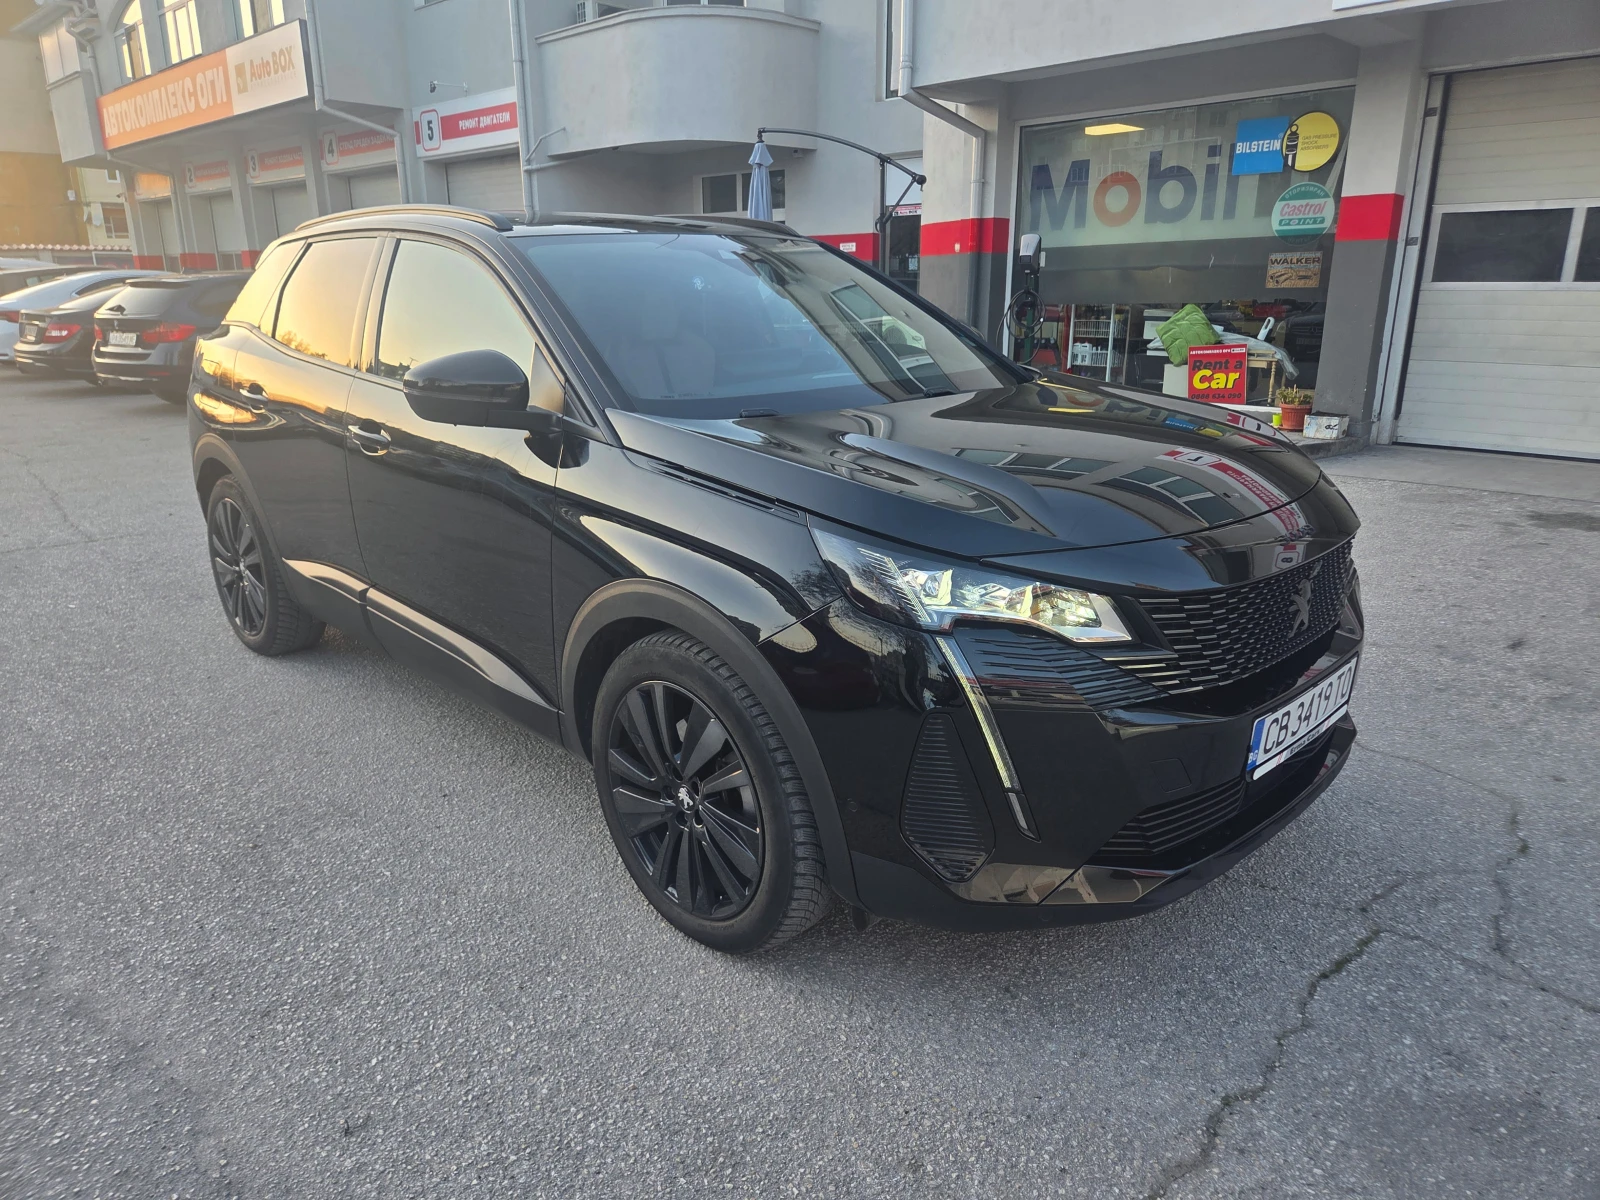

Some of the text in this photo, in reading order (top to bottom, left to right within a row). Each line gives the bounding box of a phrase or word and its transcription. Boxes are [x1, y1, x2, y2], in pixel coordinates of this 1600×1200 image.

[250, 57, 272, 83] Auto
[272, 45, 296, 76] BOX
[103, 66, 227, 138] АВТОКОМПЛЕКС ОГИ
[427, 119, 434, 142] 5
[459, 111, 511, 131] РЕМОНТ ДВИГАТЕЛИ
[327, 138, 335, 158] 4
[1235, 139, 1281, 154] BILSTEIN
[250, 154, 257, 173] 3
[187, 167, 194, 183] 2
[1284, 185, 1325, 200] ОТОРИЗИРАН
[1279, 201, 1328, 218] Castrol
[1281, 217, 1324, 226] POINT
[1270, 256, 1321, 266] WALKER
[1192, 359, 1244, 372] Rent a
[1193, 369, 1241, 390] Car
[1263, 710, 1291, 755] CB
[1291, 681, 1334, 738] 3419
